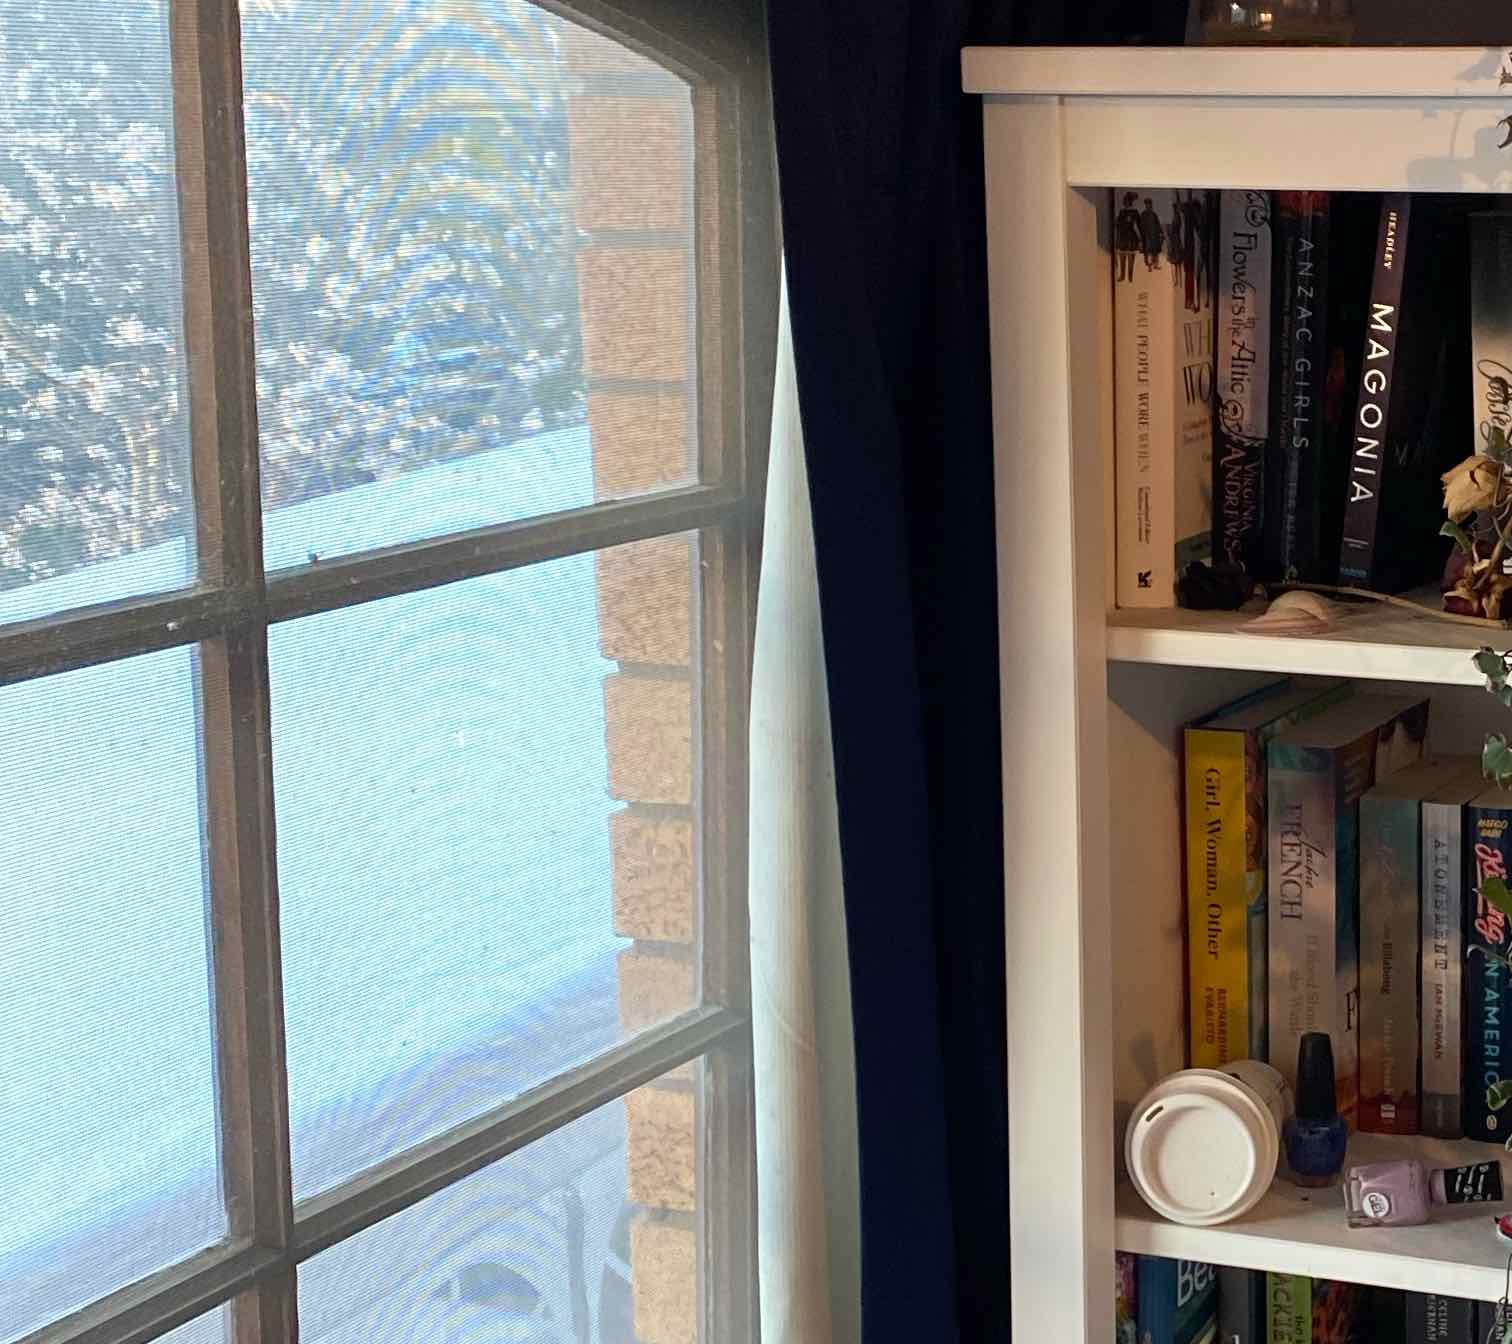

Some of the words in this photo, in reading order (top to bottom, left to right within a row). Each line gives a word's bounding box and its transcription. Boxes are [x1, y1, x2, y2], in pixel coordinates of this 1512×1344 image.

[1231, 231, 1258, 317] Flowers
[1383, 210, 1398, 272] HEADLEY
[1295, 238, 1315, 344] ANZAC
[1137, 334, 1151, 385] PEOPLE
[1229, 338, 1257, 396] Attic
[1136, 392, 1150, 427] WORE
[1292, 358, 1312, 449] GIRLS
[1350, 302, 1396, 504] MAGONIA
[1220, 444, 1247, 560] ANDREWS
[1240, 460, 1257, 532] VIRGINIA
[1206, 768, 1221, 812] Girl,
[1207, 818, 1223, 897] Woman,
[1279, 802, 1303, 921] FRENCH
[1208, 902, 1223, 960] Other
[1433, 839, 1449, 970] ATONEMENT
[1483, 988, 1501, 1088] AMERIC
[1272, 1272, 1295, 1342] ACKIE
